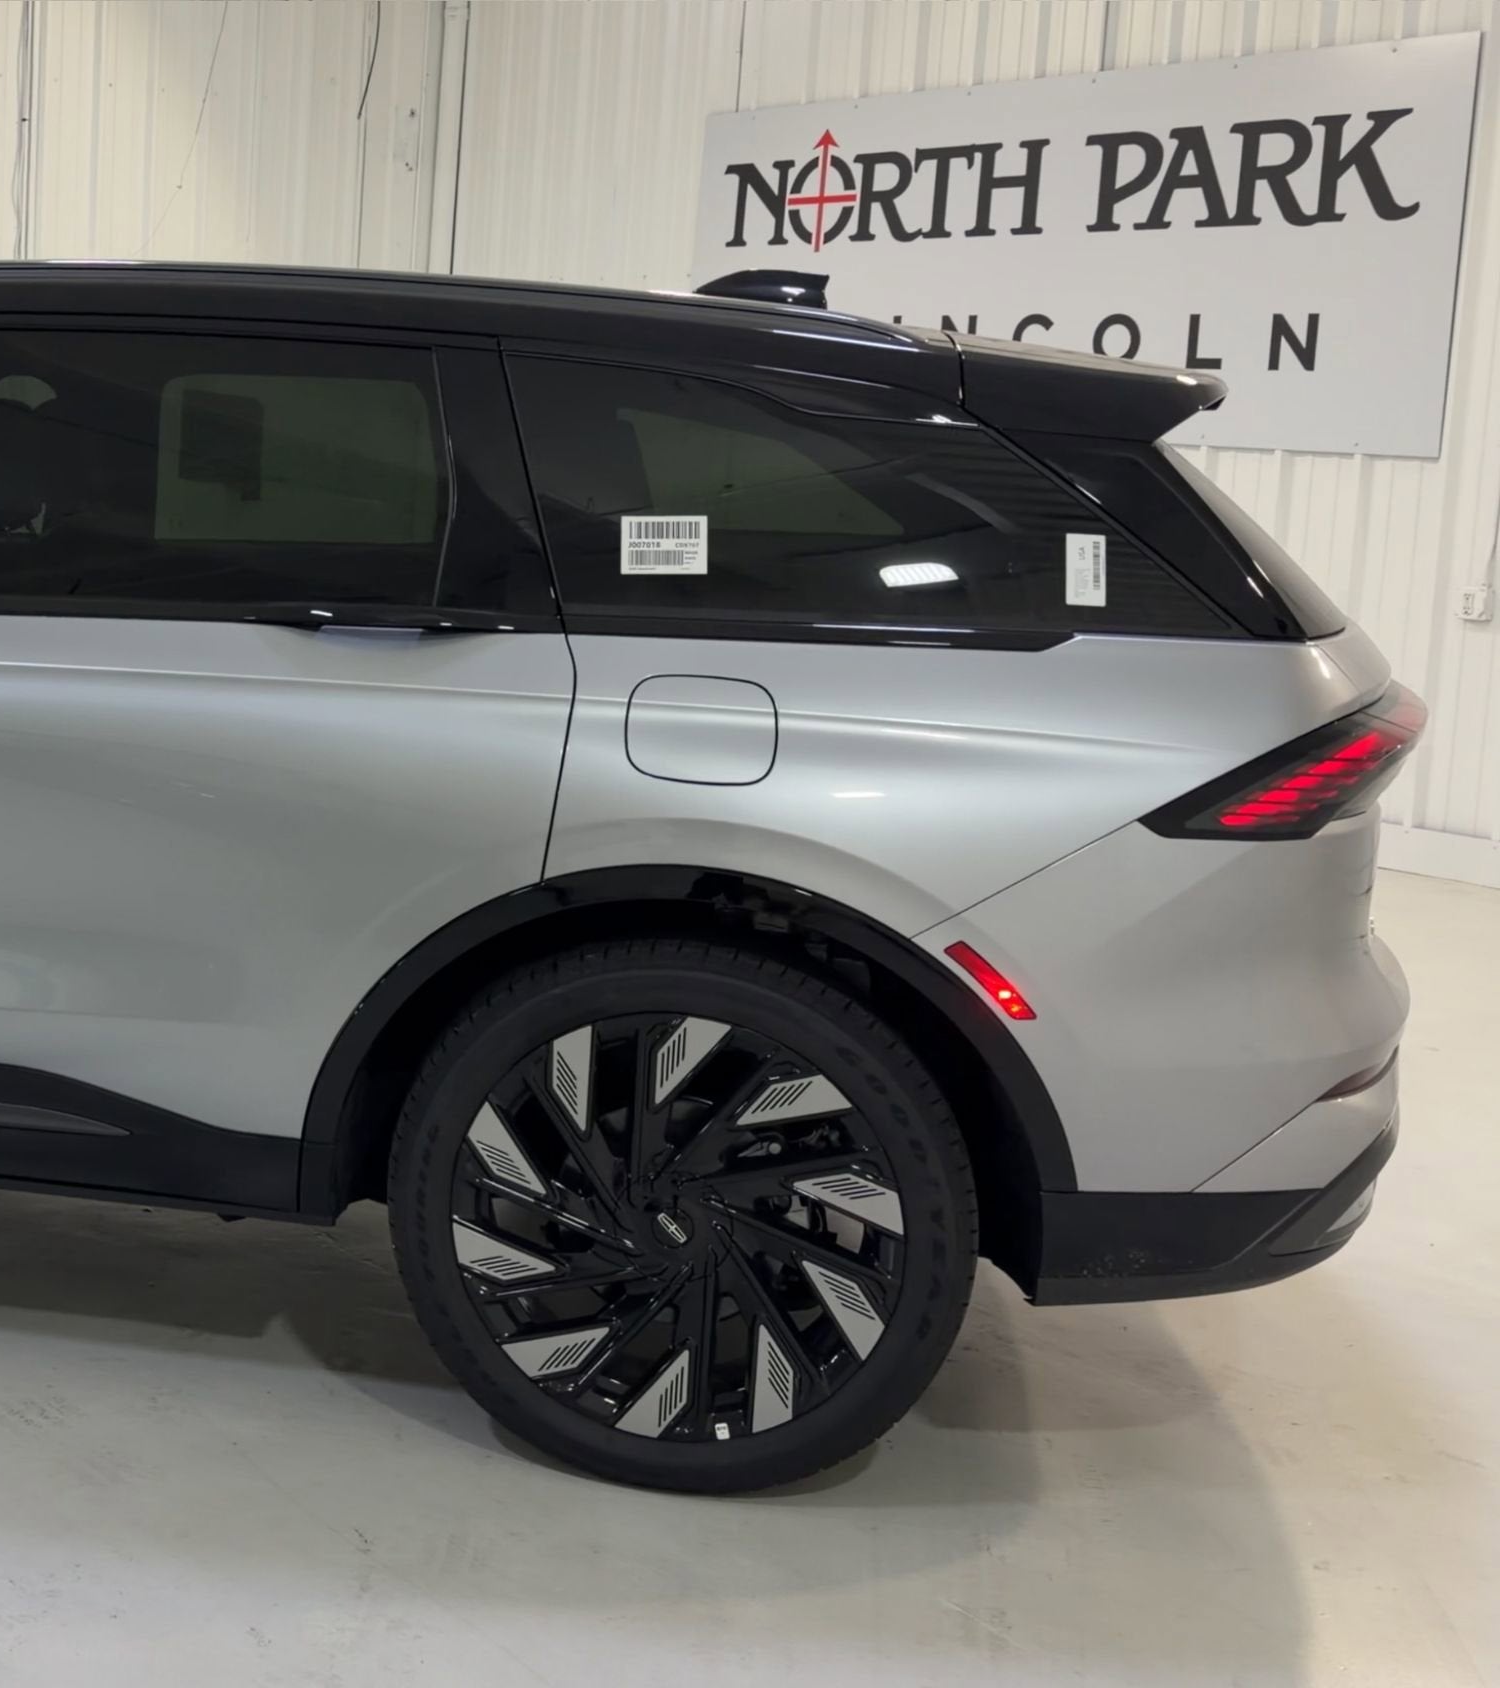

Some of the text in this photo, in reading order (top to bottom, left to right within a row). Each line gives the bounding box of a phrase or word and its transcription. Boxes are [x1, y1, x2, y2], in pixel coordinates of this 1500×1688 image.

[724, 107, 1421, 248] NORTH PARK
[892, 312, 1321, 372] COLN
[834, 1044, 948, 1342] GOODYEAR
